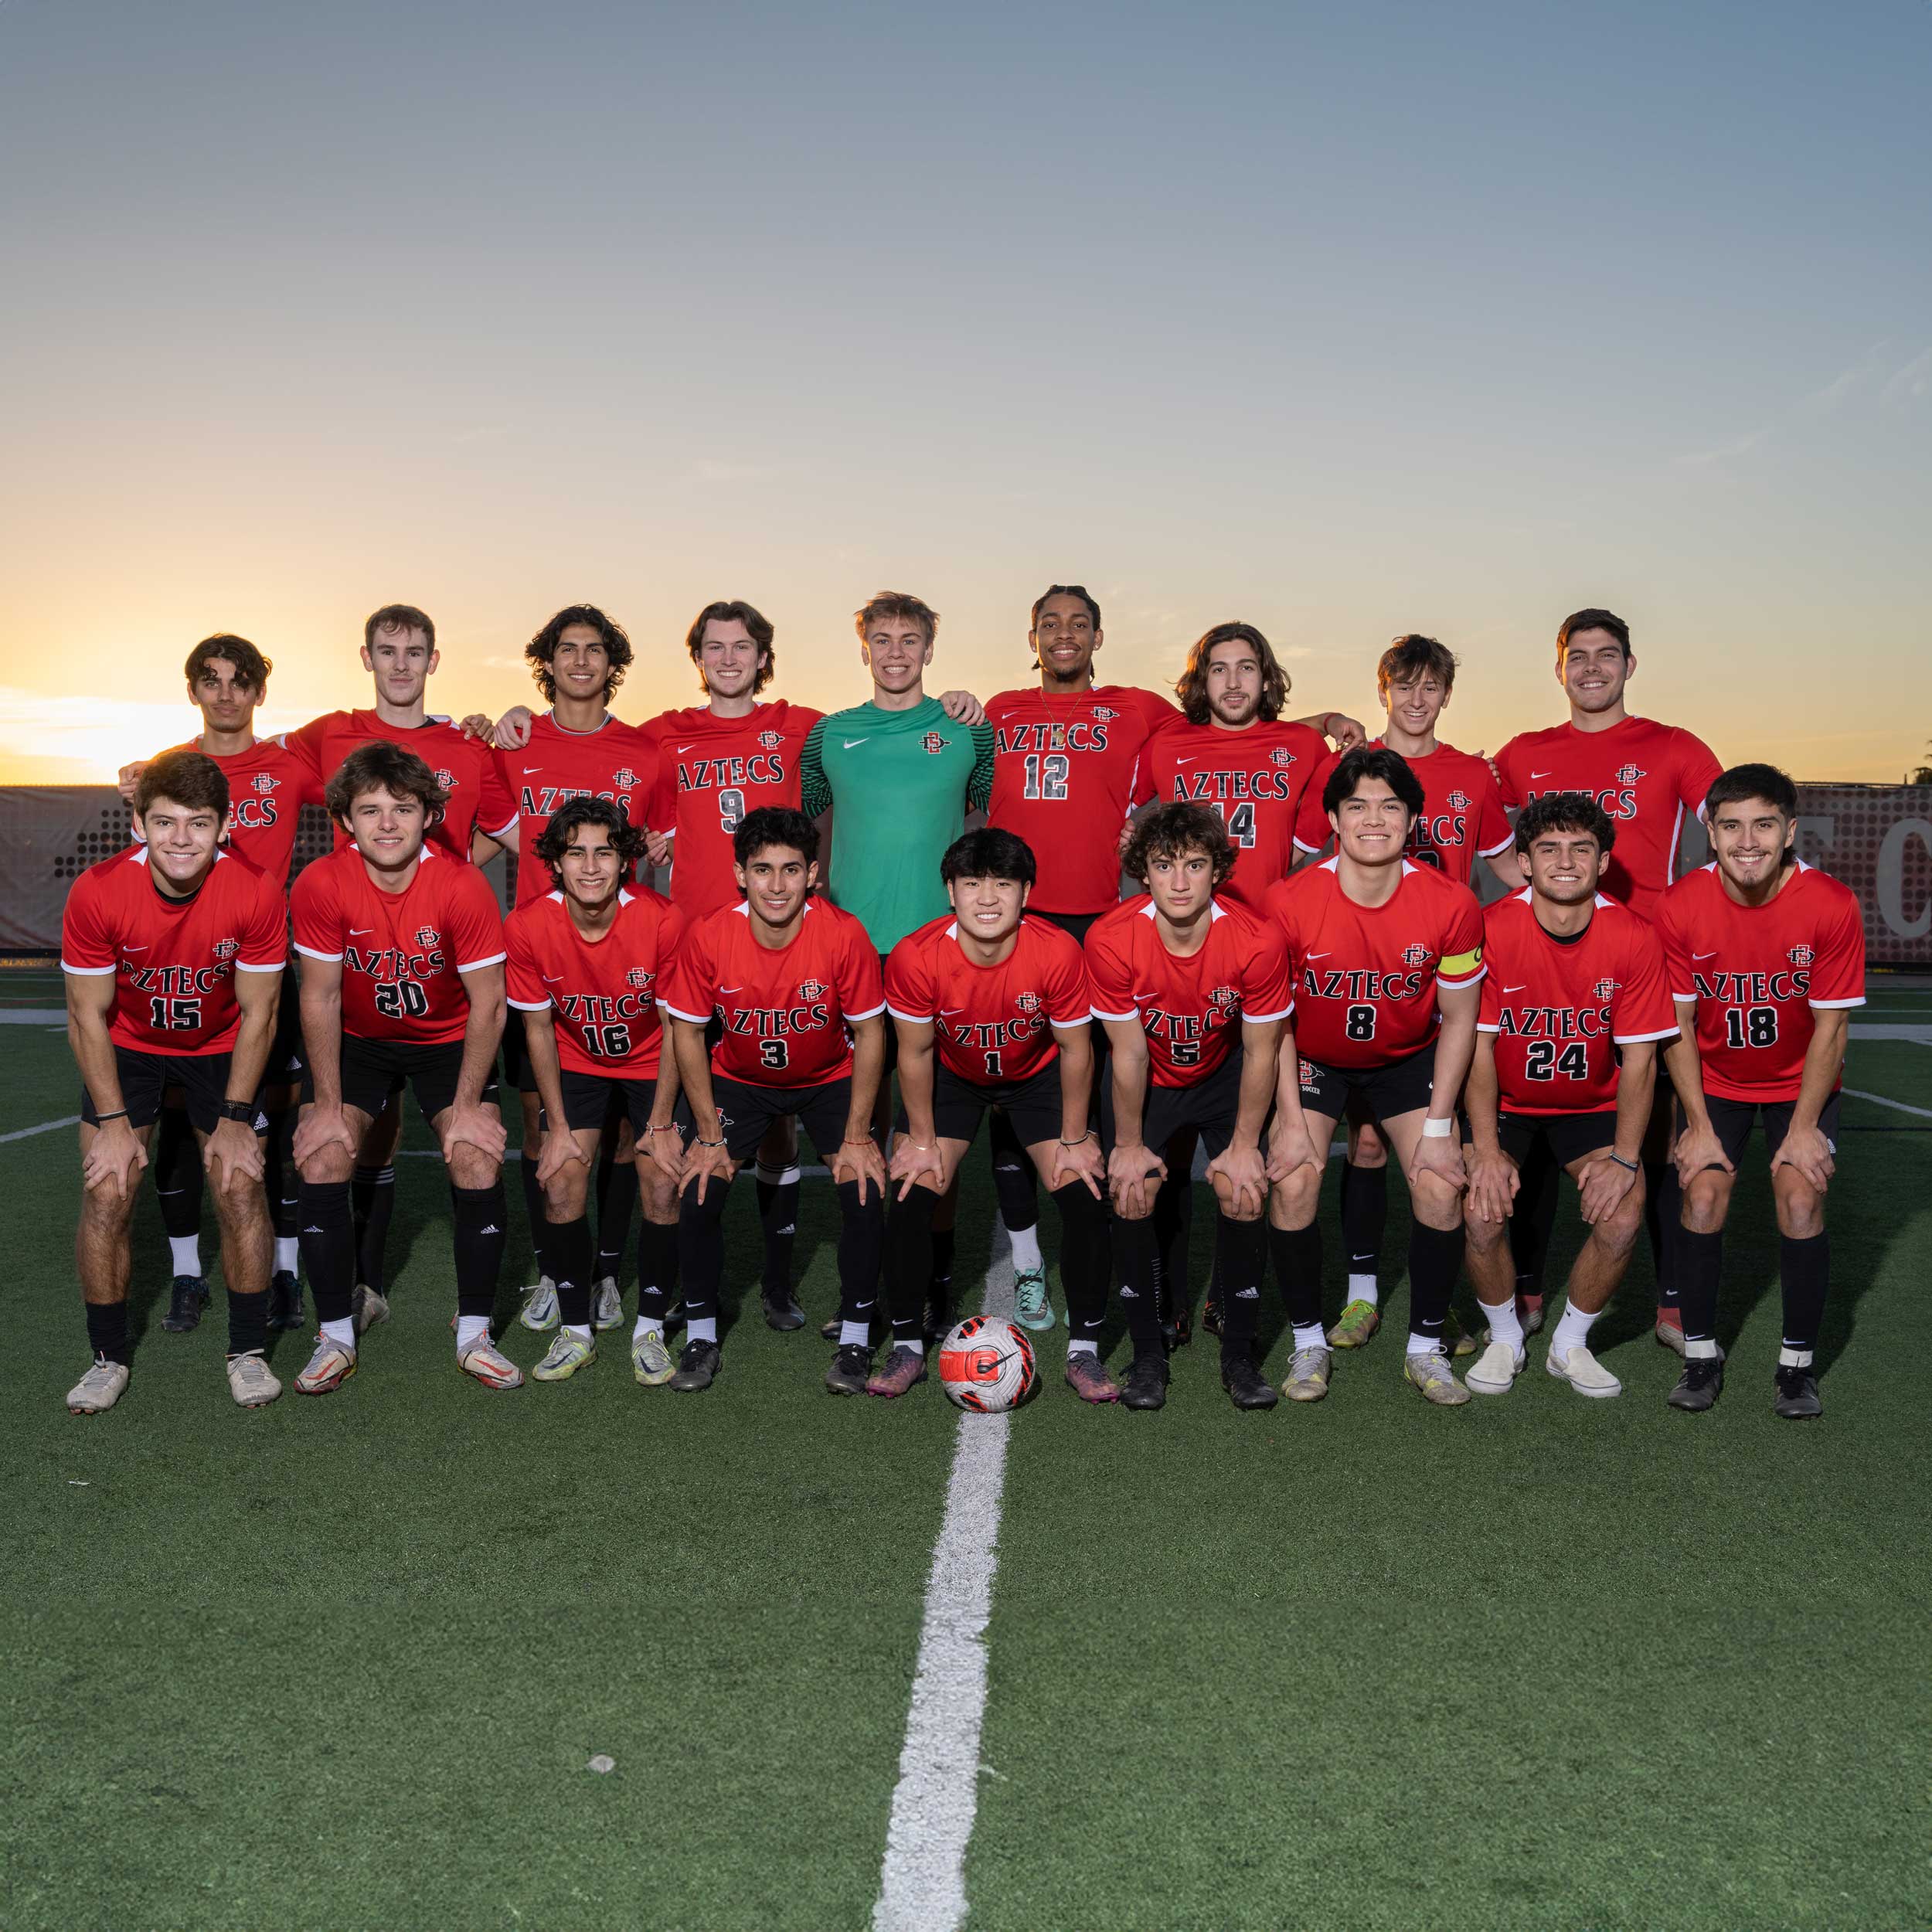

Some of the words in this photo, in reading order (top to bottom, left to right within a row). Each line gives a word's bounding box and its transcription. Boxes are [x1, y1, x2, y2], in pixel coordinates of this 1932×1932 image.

[994, 723, 1107, 754] AZTECS
[678, 754, 784, 792] AZTECS
[1023, 753, 1070, 800] 12
[1174, 770, 1290, 801] AZTECS
[718, 788, 746, 834] 9
[122, 959, 230, 995] AZTECS
[343, 946, 446, 980] AZTECS
[375, 979, 430, 1019] 20
[1303, 968, 1421, 1001] AZTECS
[1693, 971, 1810, 1004] AZTECS
[150, 996, 202, 1032] 15
[1345, 1003, 1378, 1042] 8
[1498, 1007, 1611, 1039] AZTECS
[1725, 1005, 1778, 1049] 18
[582, 1023, 631, 1057] 16
[760, 1038, 790, 1070] 3
[1171, 1041, 1201, 1067] 5
[984, 1050, 1003, 1077] 1
[1526, 1039, 1588, 1082] 24
